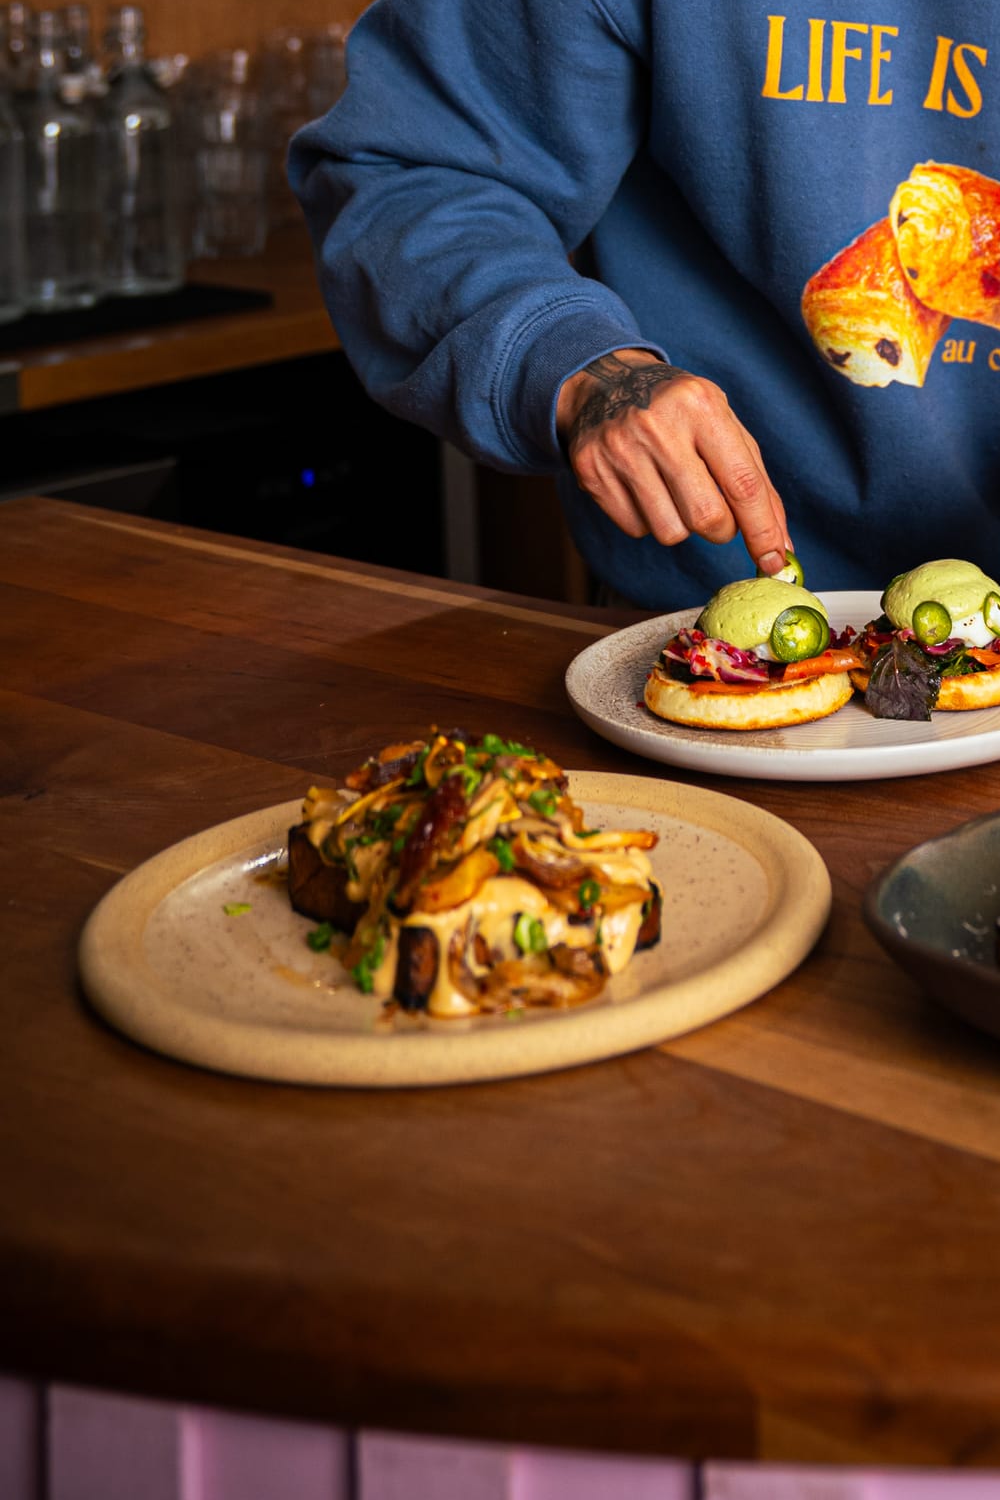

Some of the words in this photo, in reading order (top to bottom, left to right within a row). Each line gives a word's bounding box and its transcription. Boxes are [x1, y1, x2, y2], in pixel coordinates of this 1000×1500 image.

[762, 15, 899, 105] LIFE
[923, 35, 988, 118] IS
[941, 339, 977, 364] au
